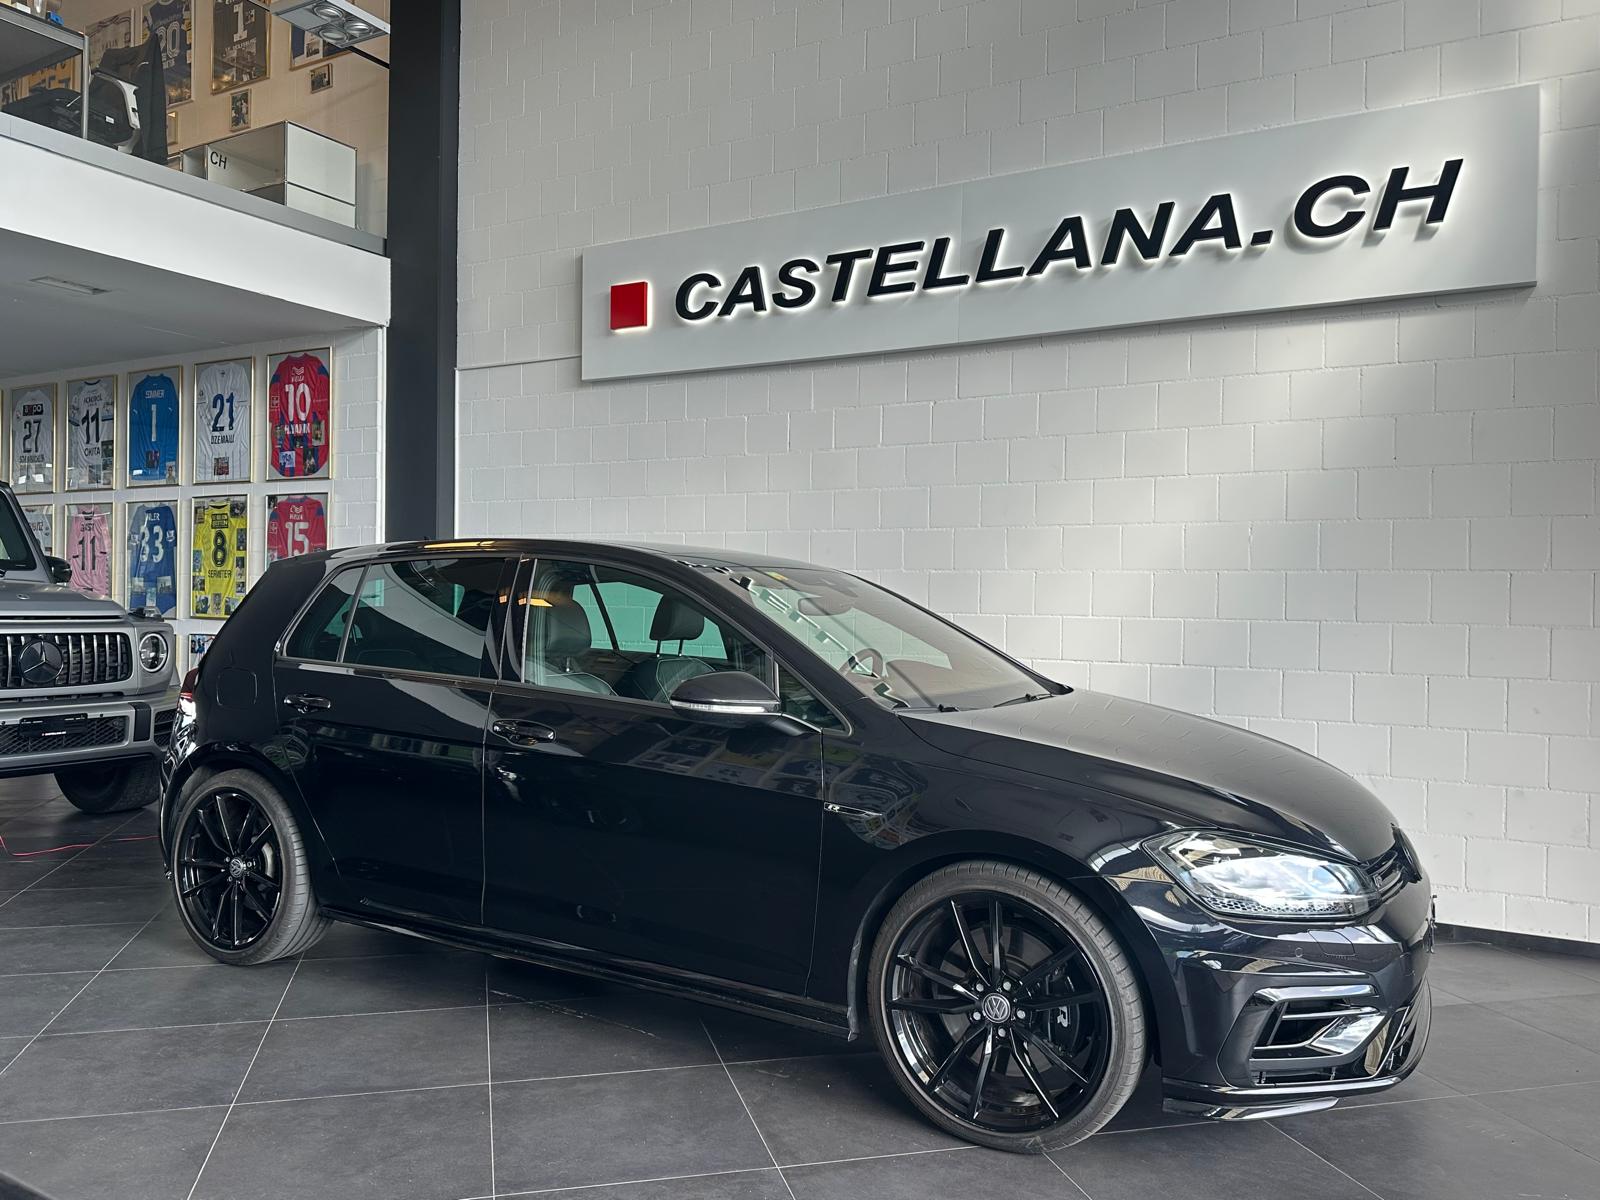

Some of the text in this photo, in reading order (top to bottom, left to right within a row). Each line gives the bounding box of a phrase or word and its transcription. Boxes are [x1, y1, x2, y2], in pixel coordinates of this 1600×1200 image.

[210, 151, 227, 169] CH
[675, 157, 1465, 322] CASTELLANA.CH
[211, 391, 235, 432] 21
[285, 383, 312, 422] 10
[22, 418, 42, 453] 27
[81, 408, 100, 444] 11
[151, 403, 157, 442] 1
[79, 535, 96, 571] 11
[213, 530, 228, 567] 8
[285, 522, 310, 557] 15
